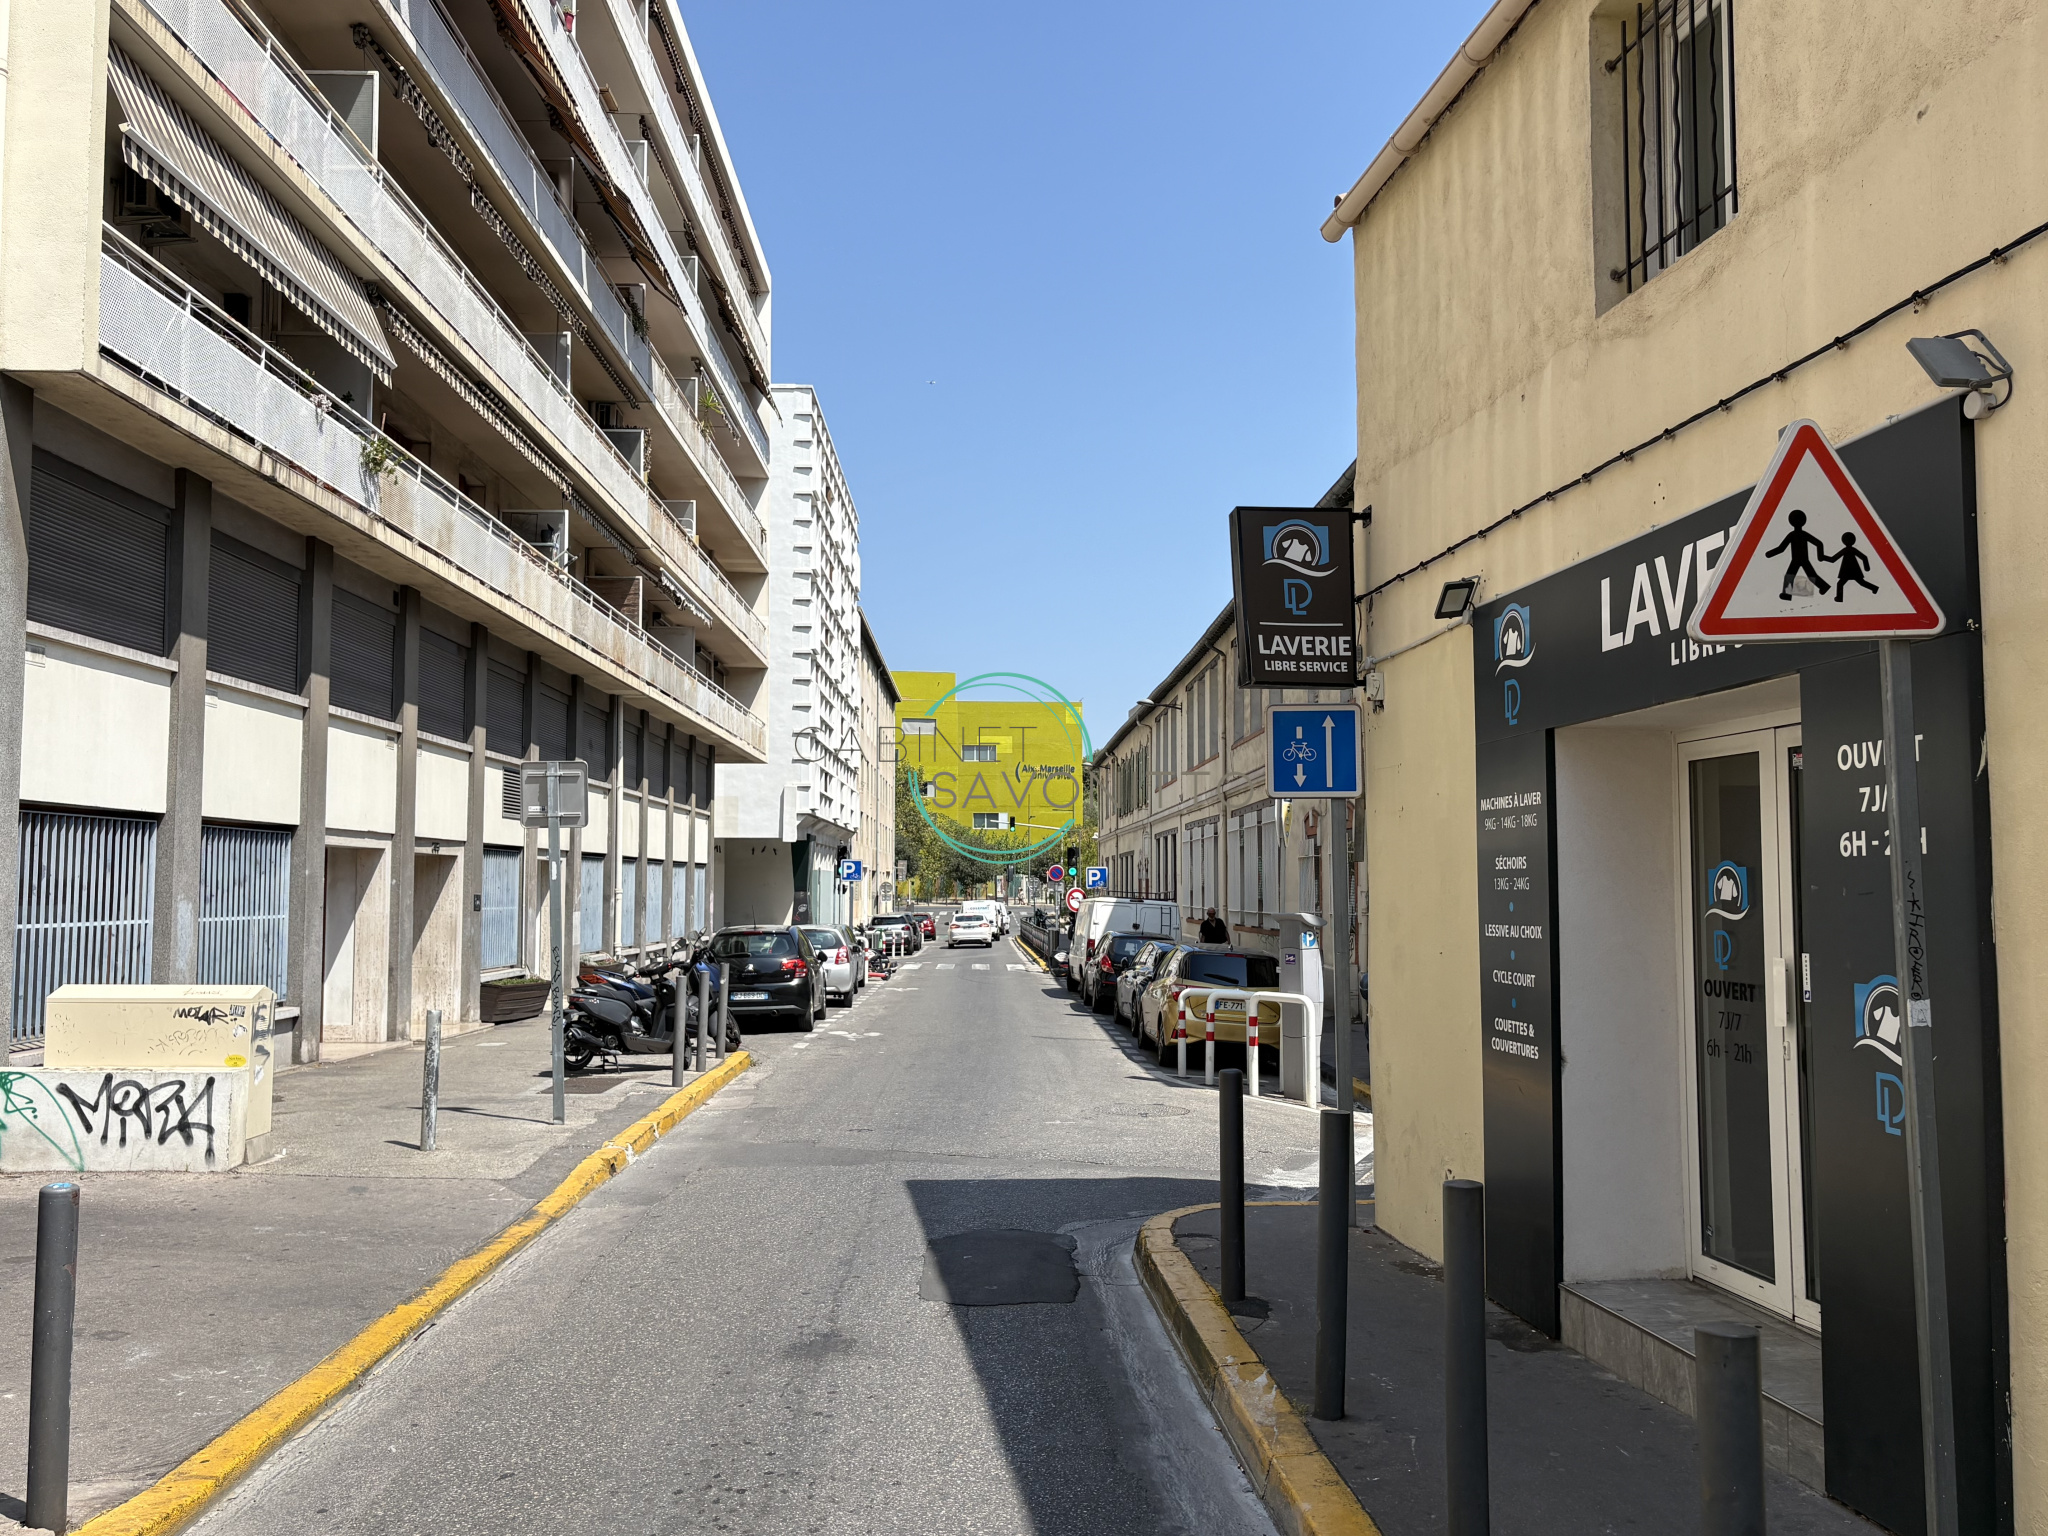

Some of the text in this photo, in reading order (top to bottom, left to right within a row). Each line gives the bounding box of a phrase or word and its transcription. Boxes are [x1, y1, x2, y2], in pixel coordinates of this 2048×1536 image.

[1601, 524, 1738, 653] LAVE
[1257, 634, 1352, 656] LAVERIE
[1264, 660, 1349, 673] LIBRE SERVICE
[1837, 734, 1924, 771] OUVT
[1480, 791, 1542, 812] MACHINES À LAVER
[1484, 817, 1497, 831] 9KG
[1501, 815, 1516, 829] 14KG
[1520, 813, 1538, 828] 18KG
[1839, 831, 1867, 858] 6H
[843, 862, 856, 878] P
[1495, 855, 1527, 870] SÉCHOIRS
[1088, 869, 1101, 886] P
[1493, 877, 1509, 890] 13KG
[1513, 876, 1530, 890] 24KG
[1306, 931, 1315, 947] P
[1485, 923, 1543, 939] LESSIVE AU CHOIX
[1492, 969, 1536, 988] CYCLE COURT
[1704, 978, 1756, 1003] OUVERT
[1494, 1017, 1535, 1038] COUETTES &
[1491, 1036, 1539, 1060] COUVERTURES
[1706, 1038, 1721, 1058] 6h
[1734, 1043, 1752, 1065] 21h
